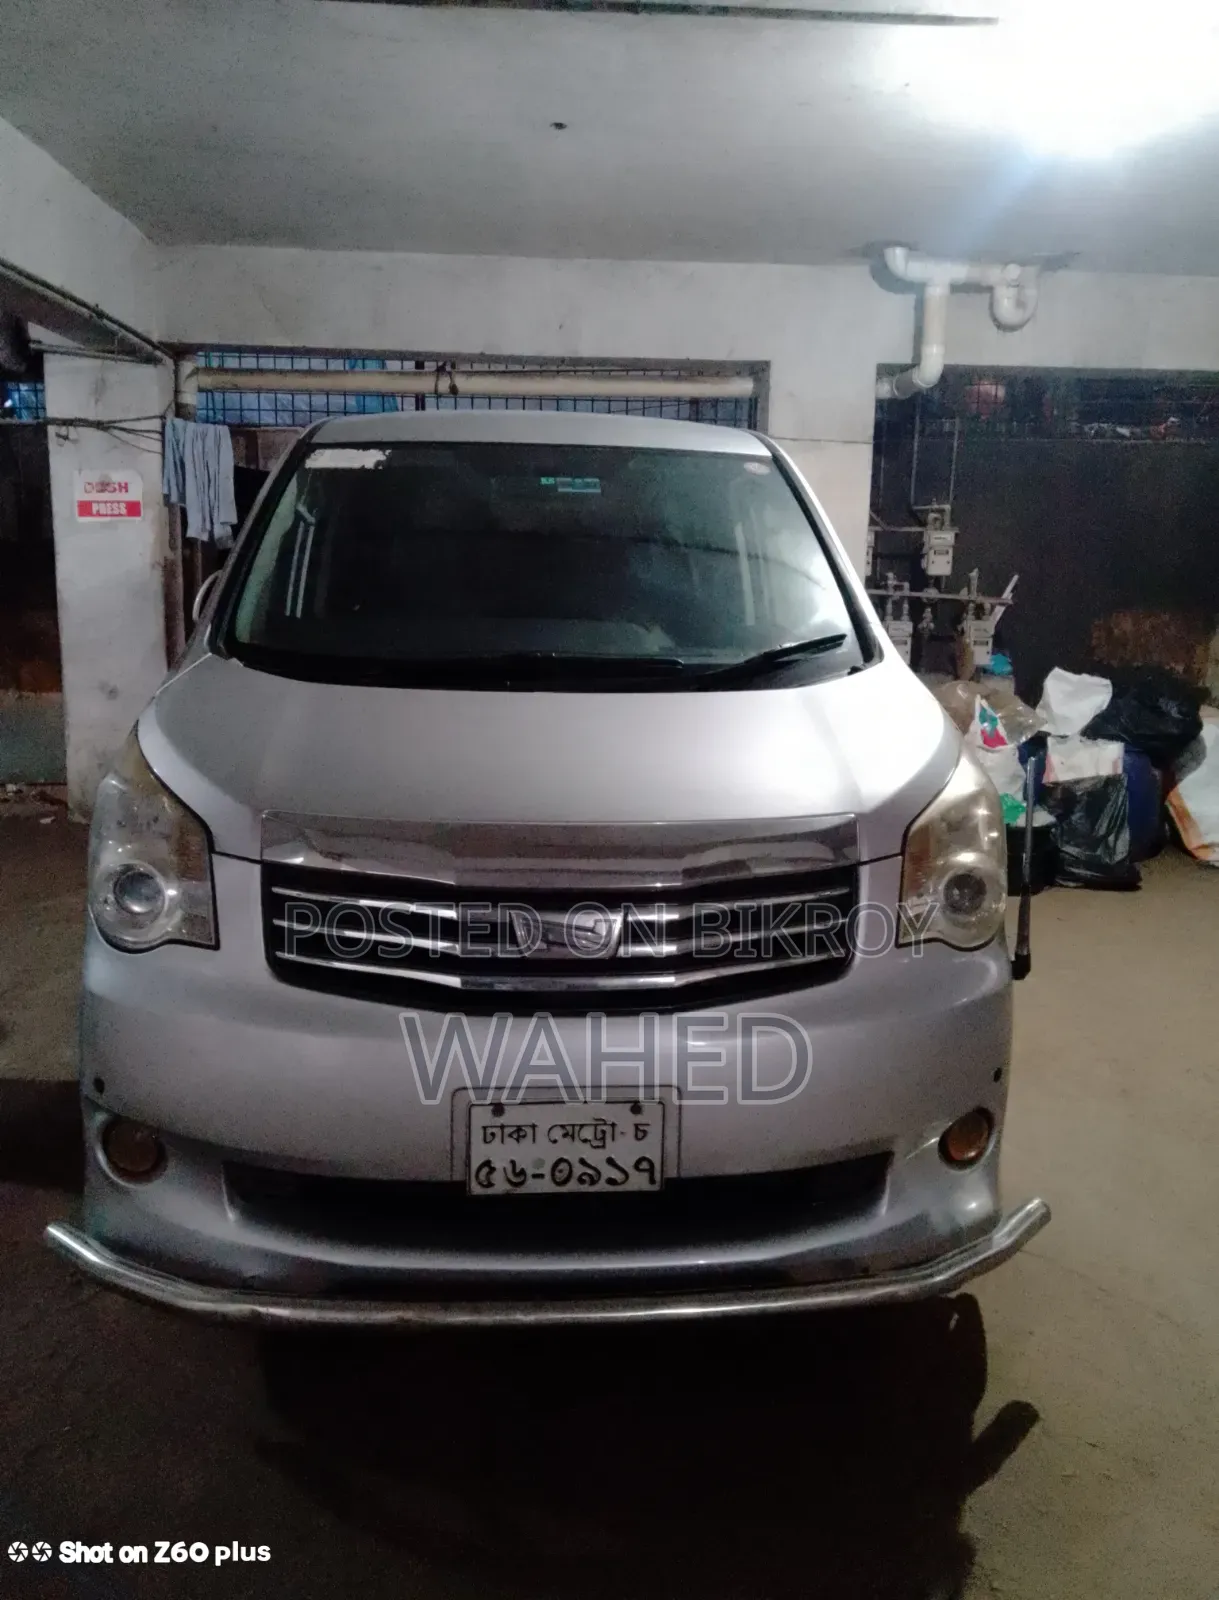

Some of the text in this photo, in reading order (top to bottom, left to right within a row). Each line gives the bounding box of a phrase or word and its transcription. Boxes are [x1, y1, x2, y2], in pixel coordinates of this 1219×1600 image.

[92, 501, 127, 515] PRESS
[481, 1122, 537, 1145] ঢাকা
[475, 1156, 656, 1188] ৫৬-০৯১৭
